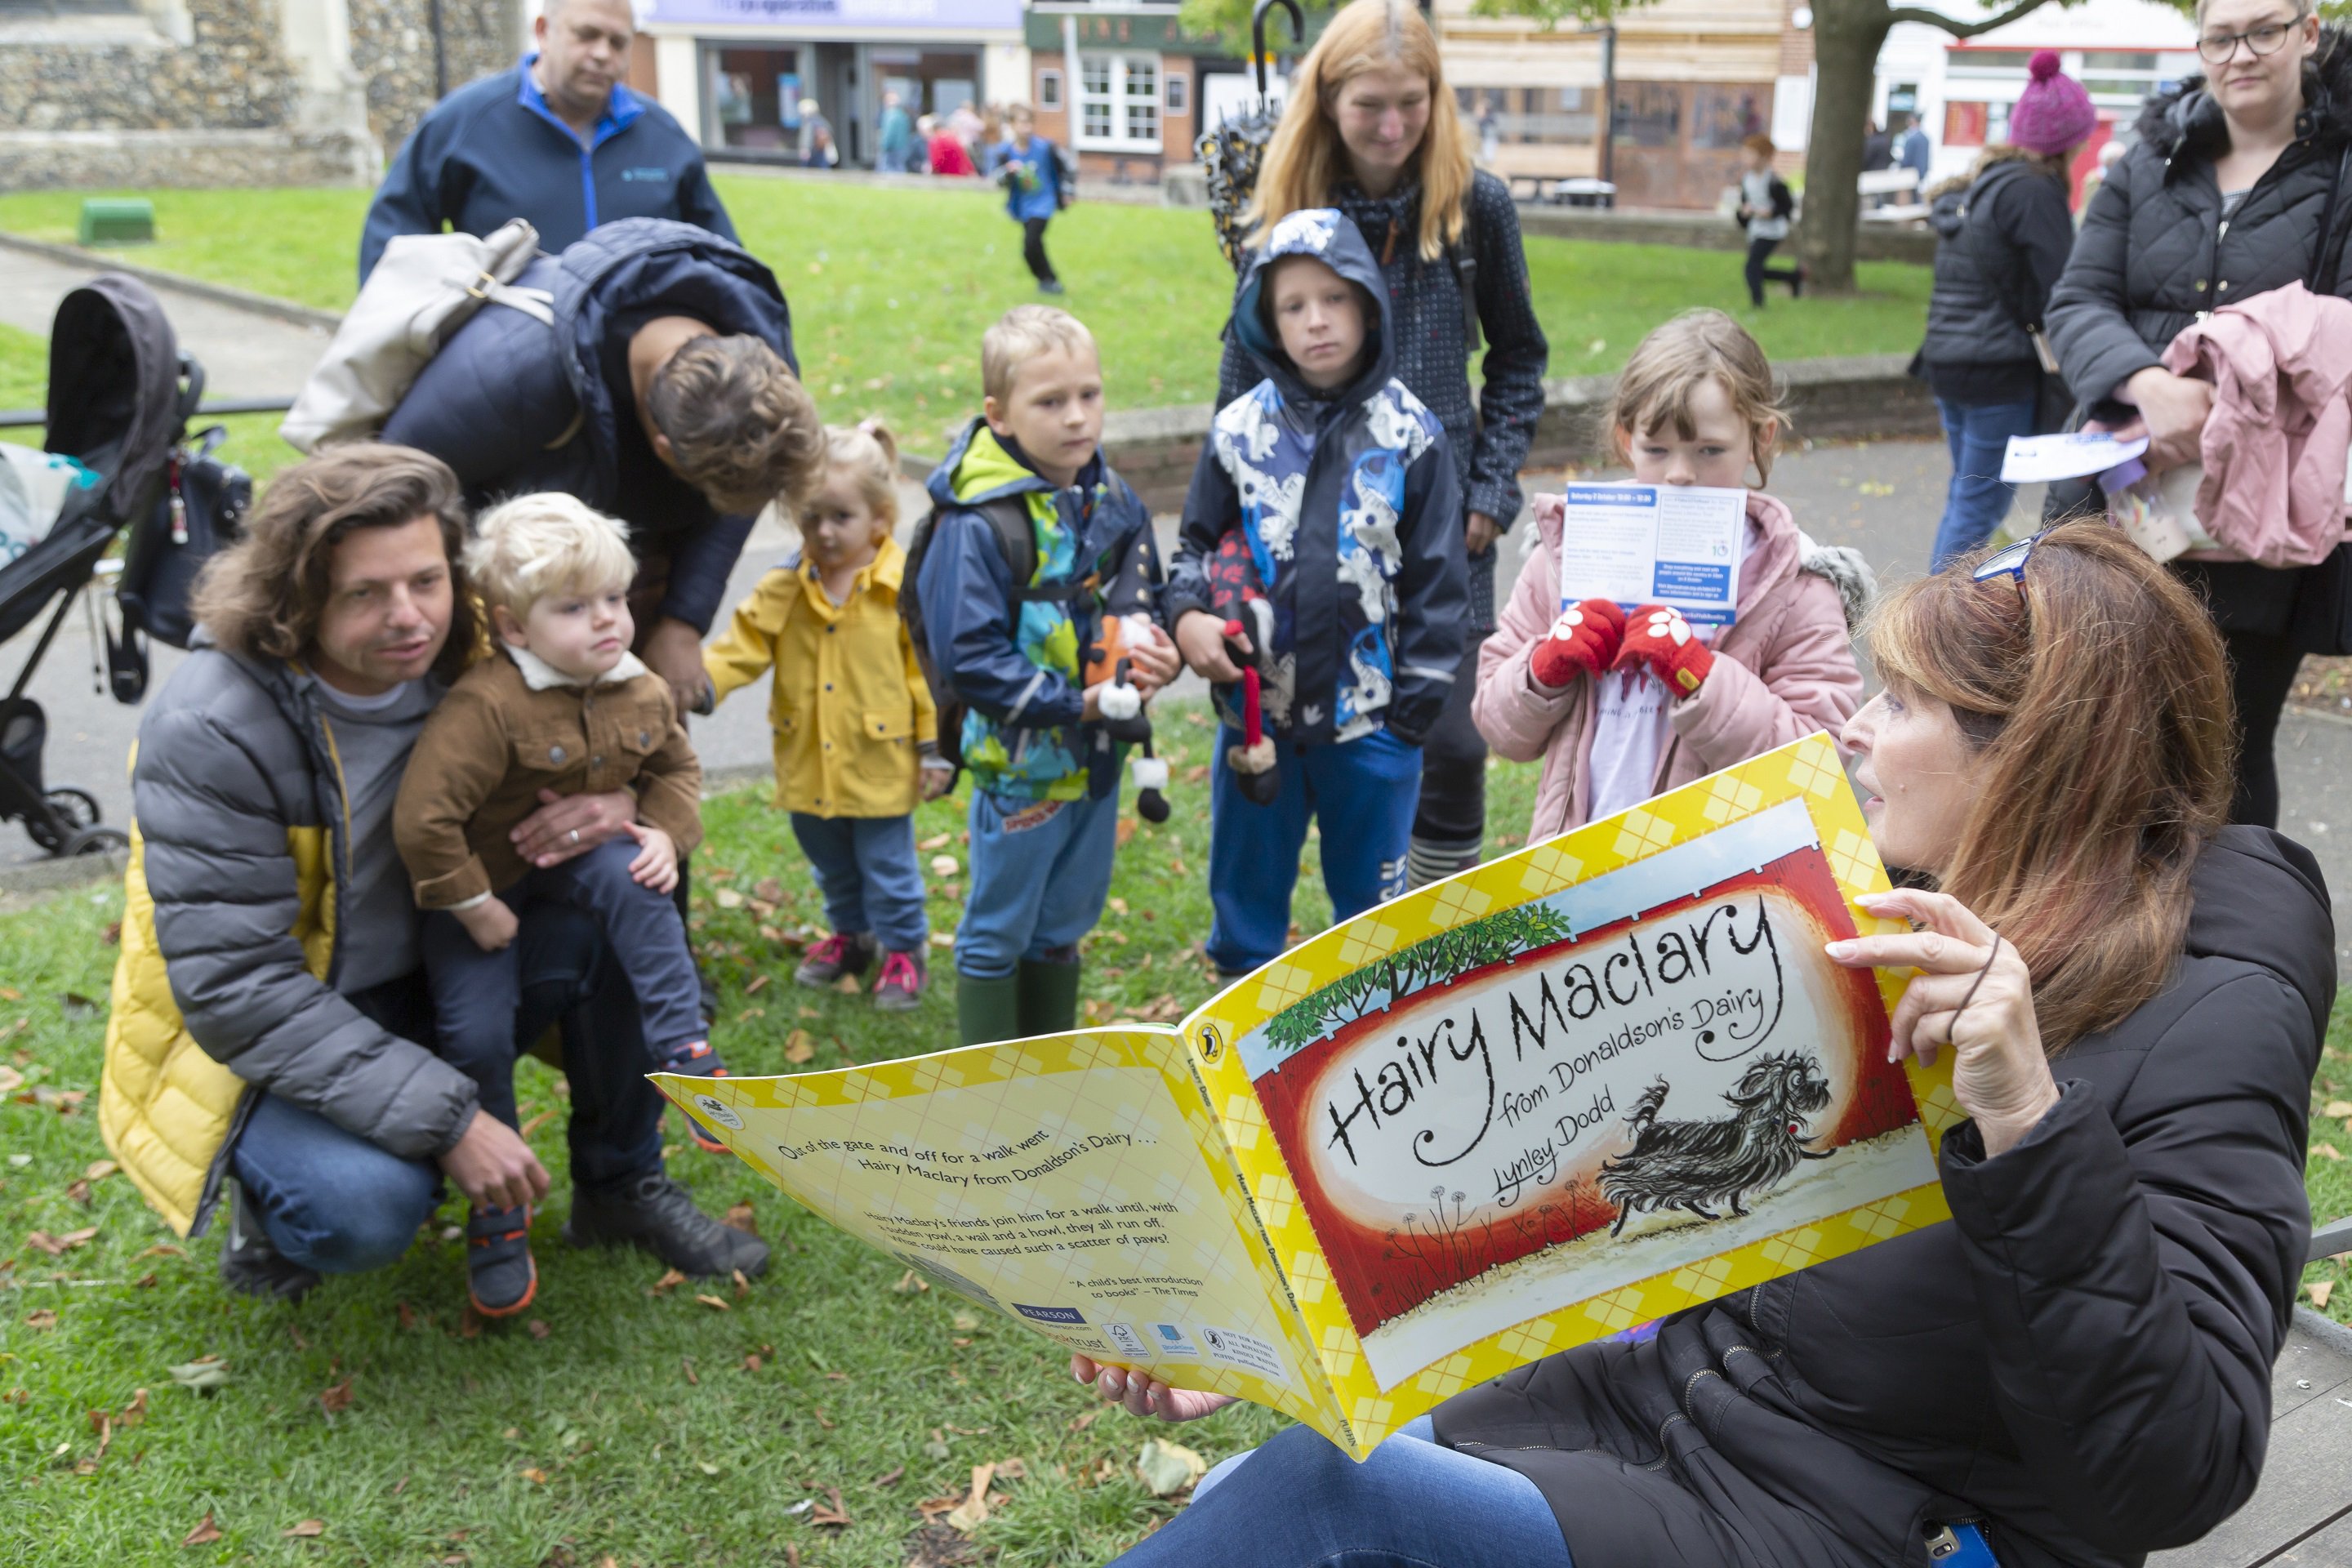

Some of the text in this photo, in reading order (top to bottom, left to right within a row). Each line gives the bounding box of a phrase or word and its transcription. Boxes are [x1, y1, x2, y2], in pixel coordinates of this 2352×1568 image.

[1328, 894, 1784, 1167] Hairy Maclary
[1498, 986, 1764, 1129] from Donaldson's Dairy
[778, 1130, 1049, 1164] Out of the gate and off for a walk went
[1494, 1083, 1616, 1208] Lynley Dodd
[858, 1159, 900, 1174] Hairy
[906, 1164, 969, 1187] Maclary
[973, 1174, 1012, 1185] from
[1011, 1143, 1089, 1181] Donaldson's
[1087, 1133, 1132, 1148] Dairy
[863, 1201, 1179, 1230] Hairy Maclary's friends join him for a walk until, with
[884, 1226, 924, 1238] sudden
[926, 1232, 956, 1242] yowl,
[965, 1232, 991, 1241] wail
[992, 1230, 1016, 1241] and
[1029, 1225, 1066, 1238] howl,
[1066, 1222, 1094, 1235] they
[1099, 1219, 1113, 1230] all
[1116, 1220, 1140, 1229] run
[1143, 1217, 1165, 1228] off.
[889, 1232, 1170, 1255] What could have caused such a scatter of paws?
[1088, 1277, 1118, 1287] child's
[1143, 1276, 1204, 1286] introduction
[1152, 1287, 1171, 1295] The
[1173, 1287, 1199, 1297] Times
[1021, 1307, 1076, 1320] PEARSON
[1340, 1419, 1357, 1447] PUFFIN
